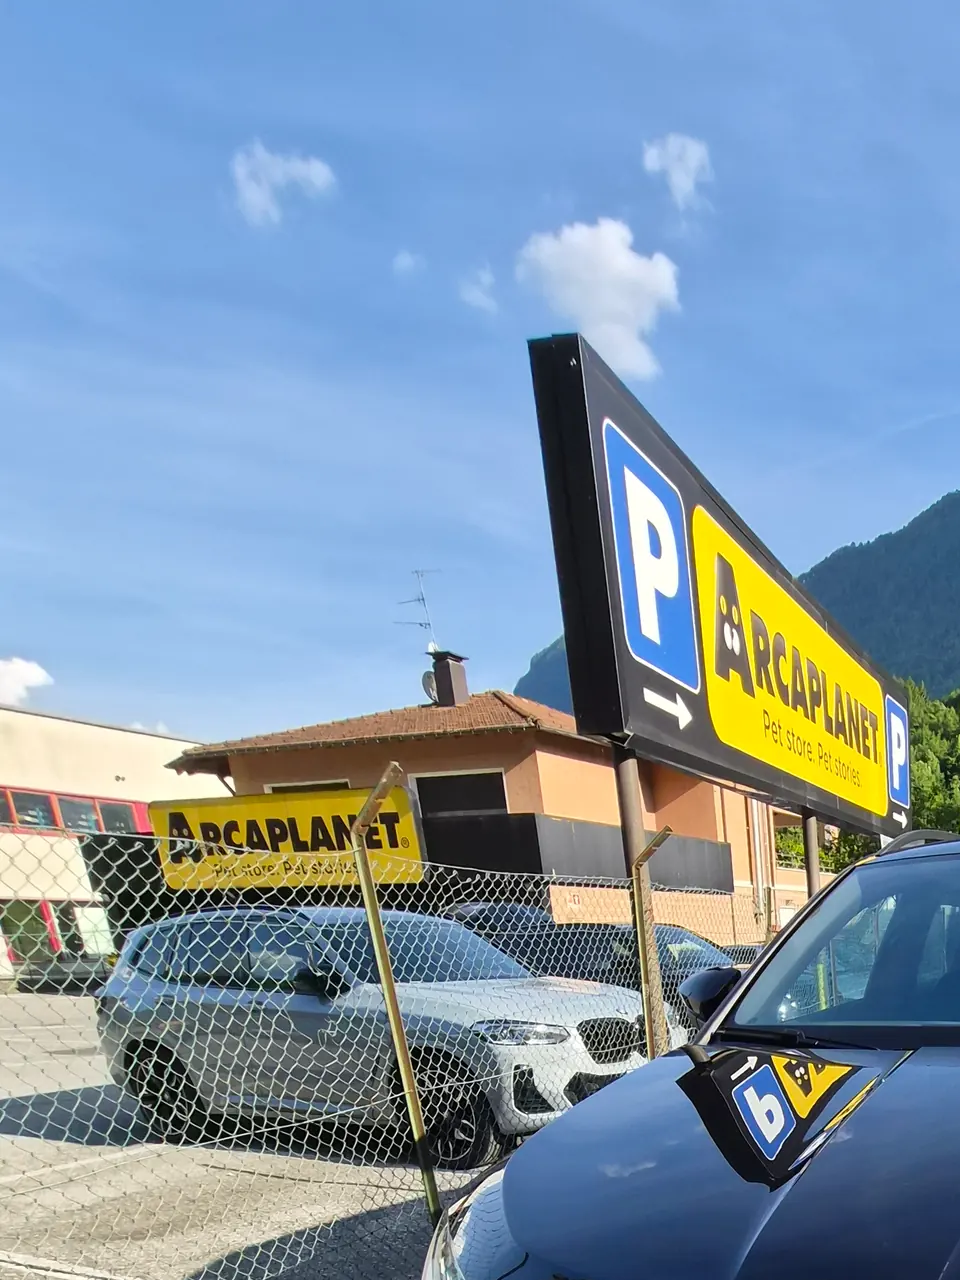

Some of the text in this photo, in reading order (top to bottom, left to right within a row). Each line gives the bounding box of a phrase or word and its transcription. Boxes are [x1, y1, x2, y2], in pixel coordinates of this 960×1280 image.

[624, 465, 680, 646] P
[715, 551, 879, 765] ARCAPLANET
[763, 708, 863, 788] Pet store. Pet stories.
[890, 711, 906, 791] P
[168, 811, 400, 864] ARCAPLANET
[283, 860, 309, 875] Pet
